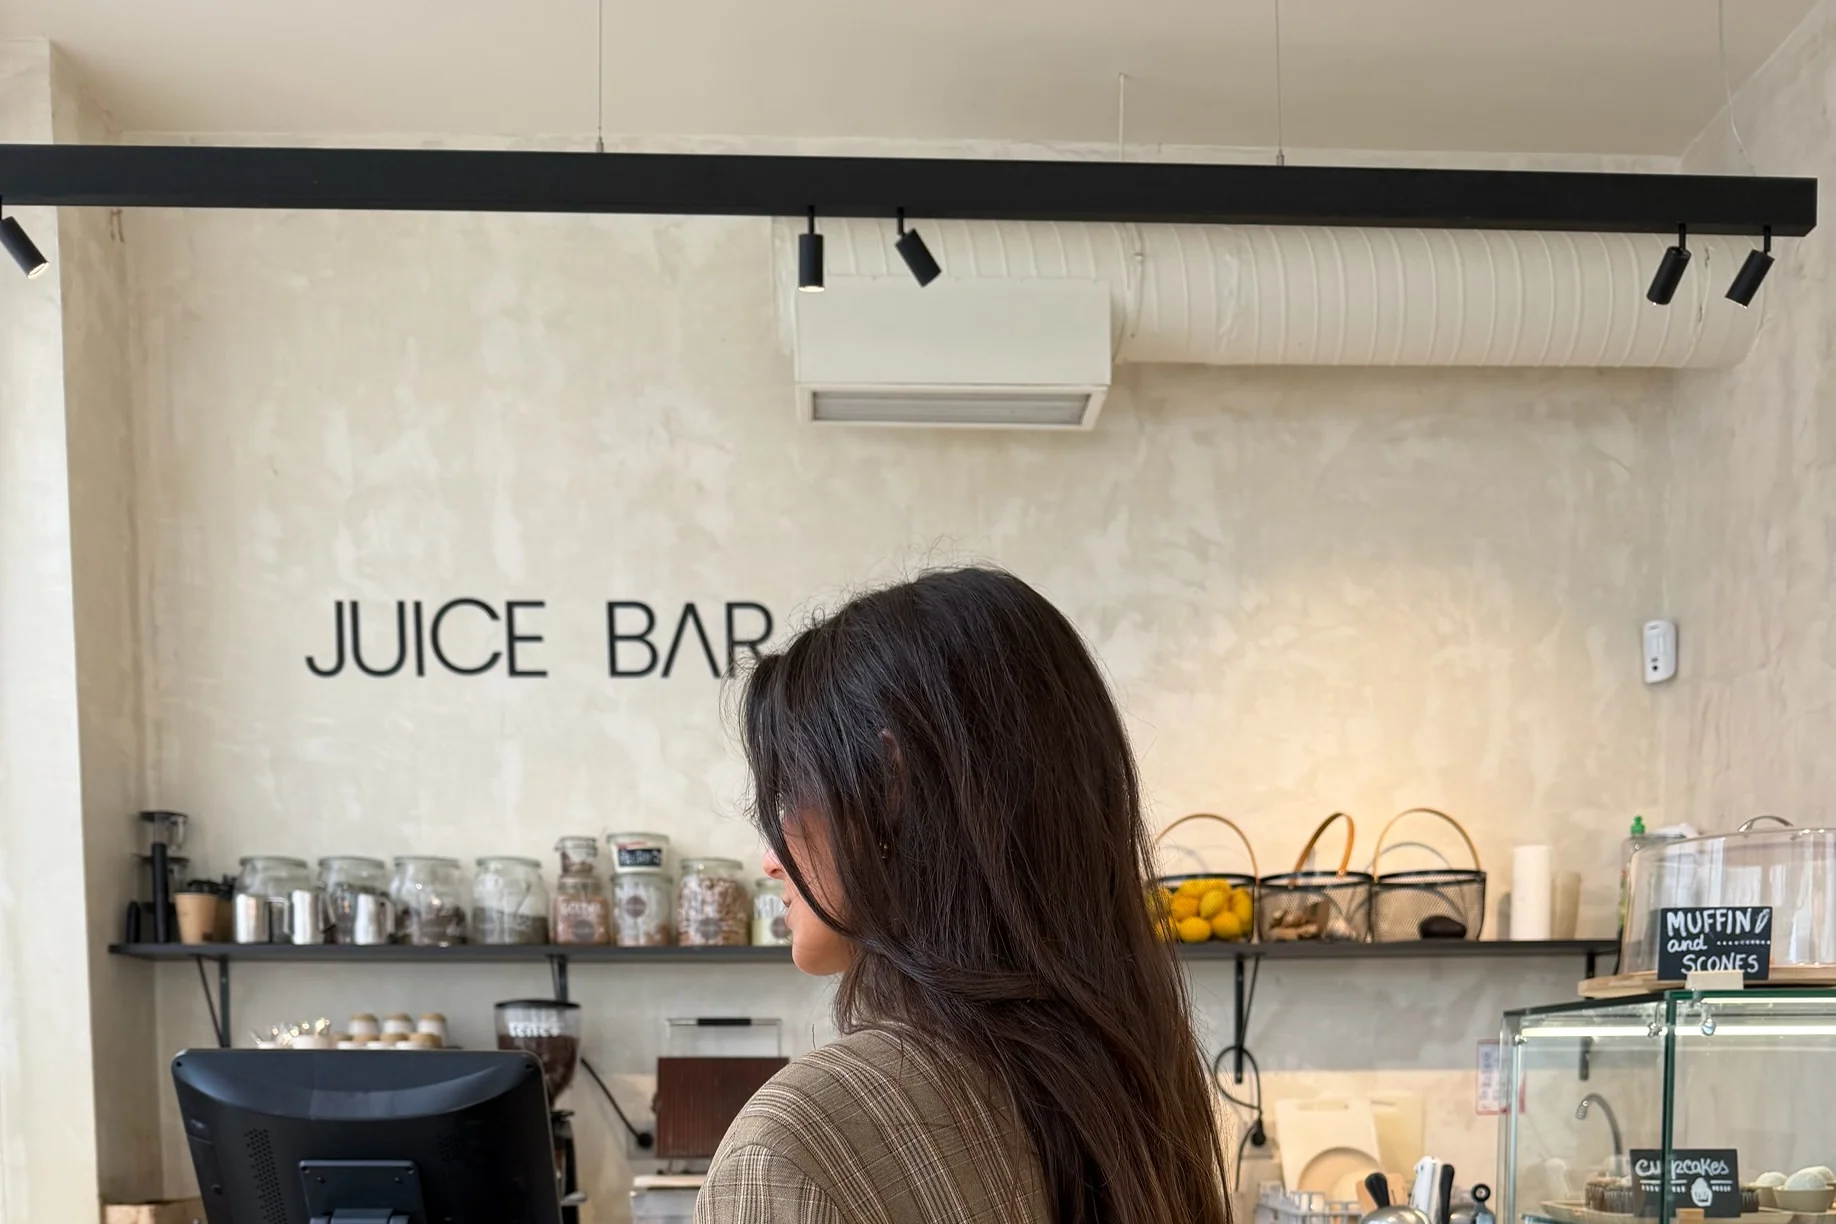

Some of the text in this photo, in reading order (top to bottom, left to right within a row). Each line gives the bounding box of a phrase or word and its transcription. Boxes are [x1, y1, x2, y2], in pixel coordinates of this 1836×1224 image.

[304, 596, 774, 680] JUICE BAR
[1667, 934, 1708, 953] and
[1681, 952, 1759, 974] SCONES
